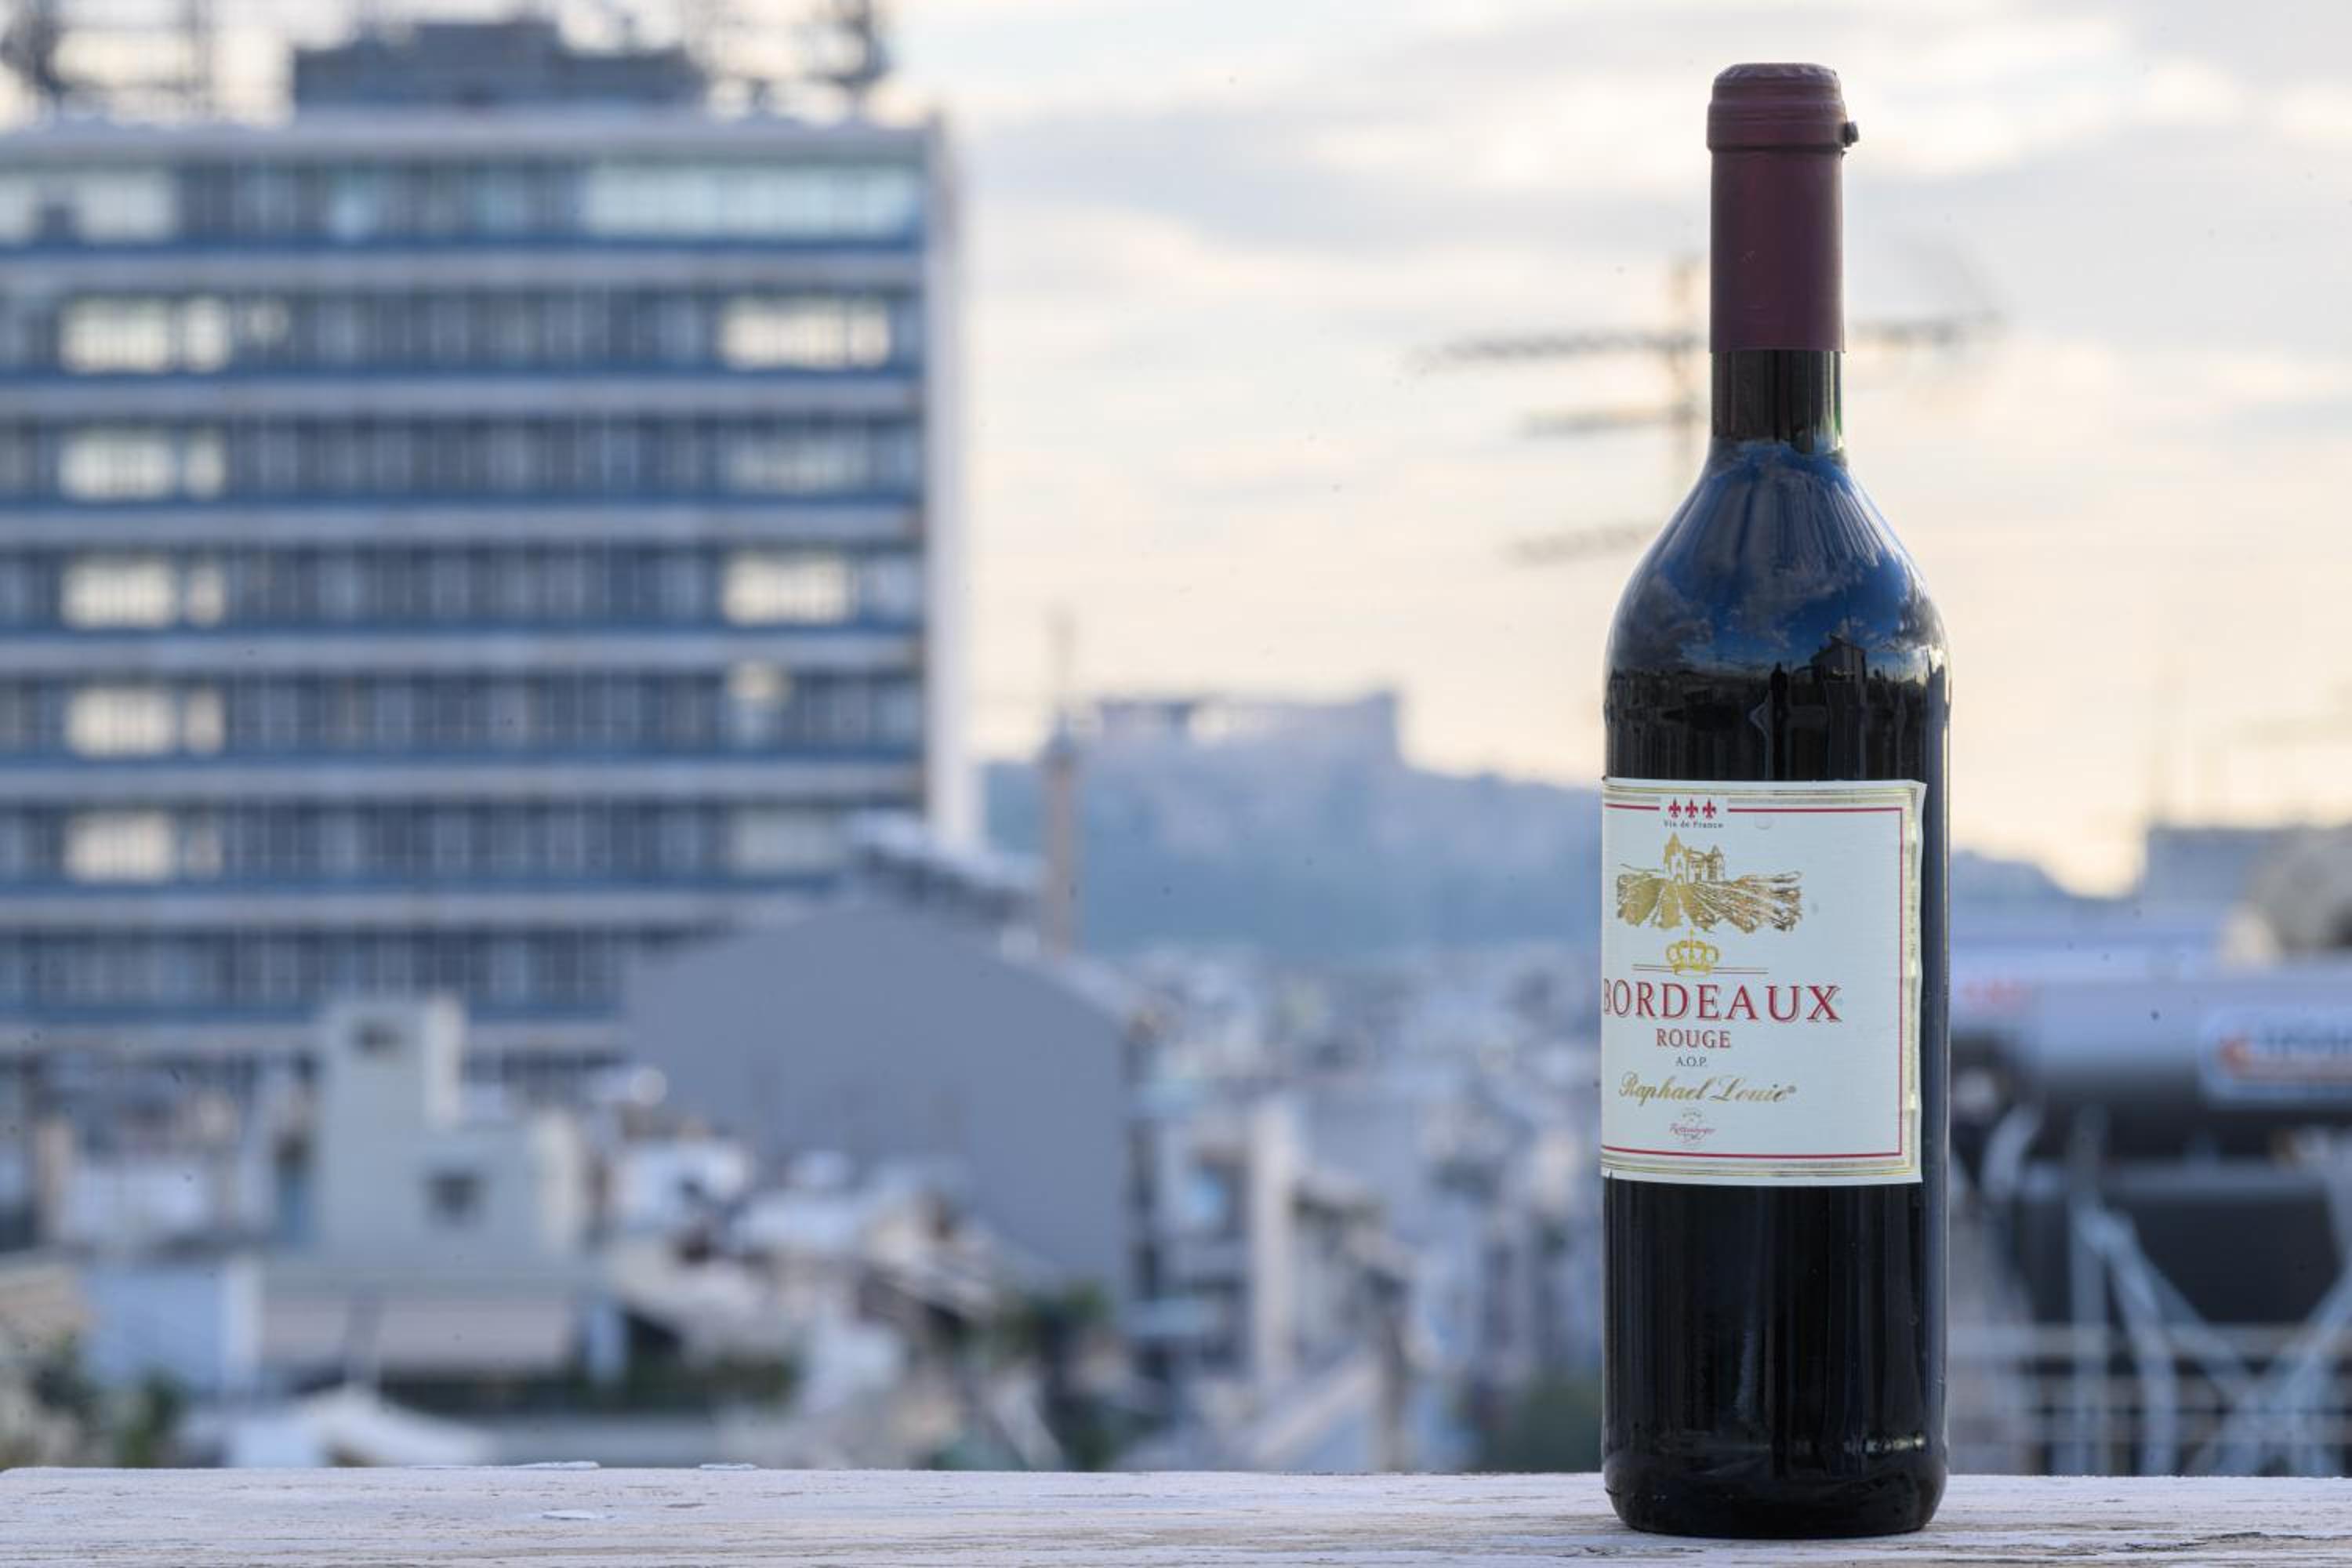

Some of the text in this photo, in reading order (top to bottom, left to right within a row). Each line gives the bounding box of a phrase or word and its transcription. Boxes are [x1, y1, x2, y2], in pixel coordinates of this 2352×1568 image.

[1693, 820, 1724, 829] France
[1603, 978, 1843, 1023] BORDEAUX
[1656, 1027, 1732, 1049] ROUGE
[1675, 1056, 1708, 1068] A.O.P.
[1619, 1070, 1716, 1106] Raphael
